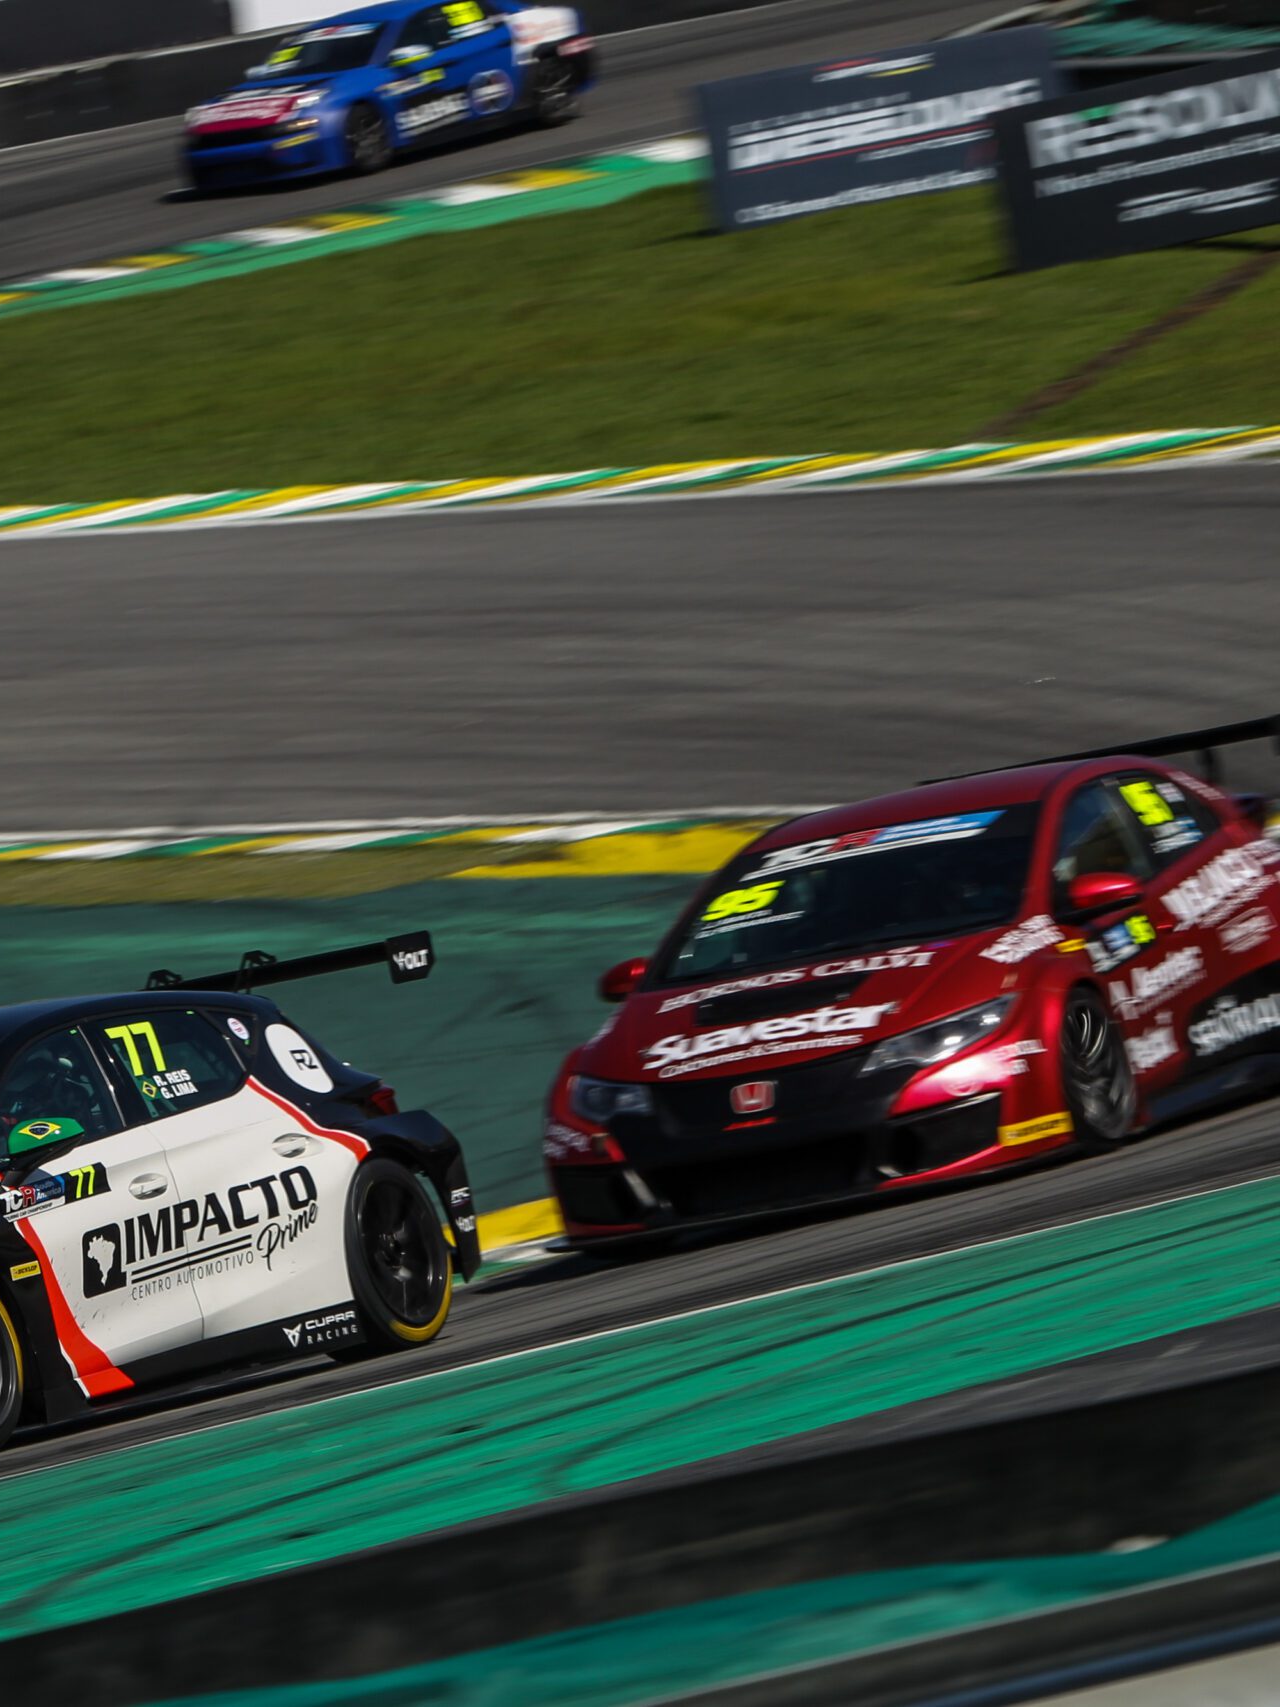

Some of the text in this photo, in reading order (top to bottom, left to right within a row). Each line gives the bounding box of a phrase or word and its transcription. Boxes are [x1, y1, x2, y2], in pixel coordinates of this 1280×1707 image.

[701, 880, 786, 922] 95
[393, 949, 428, 970] VOLT
[811, 951, 938, 978] CALVI
[104, 1021, 167, 1076] 77
[643, 1002, 893, 1070] Suavestar
[152, 1069, 191, 1087] R. REIS
[160, 1082, 199, 1099] G. LIMA
[69, 1165, 96, 1199] 77
[124, 1165, 318, 1266] IMPACTO
[256, 1202, 318, 1272] Prime
[131, 1251, 255, 1301] CENTRO AUTOMOTIVO
[305, 1310, 356, 1330] CUPRA
[306, 1324, 359, 1344] RACING
